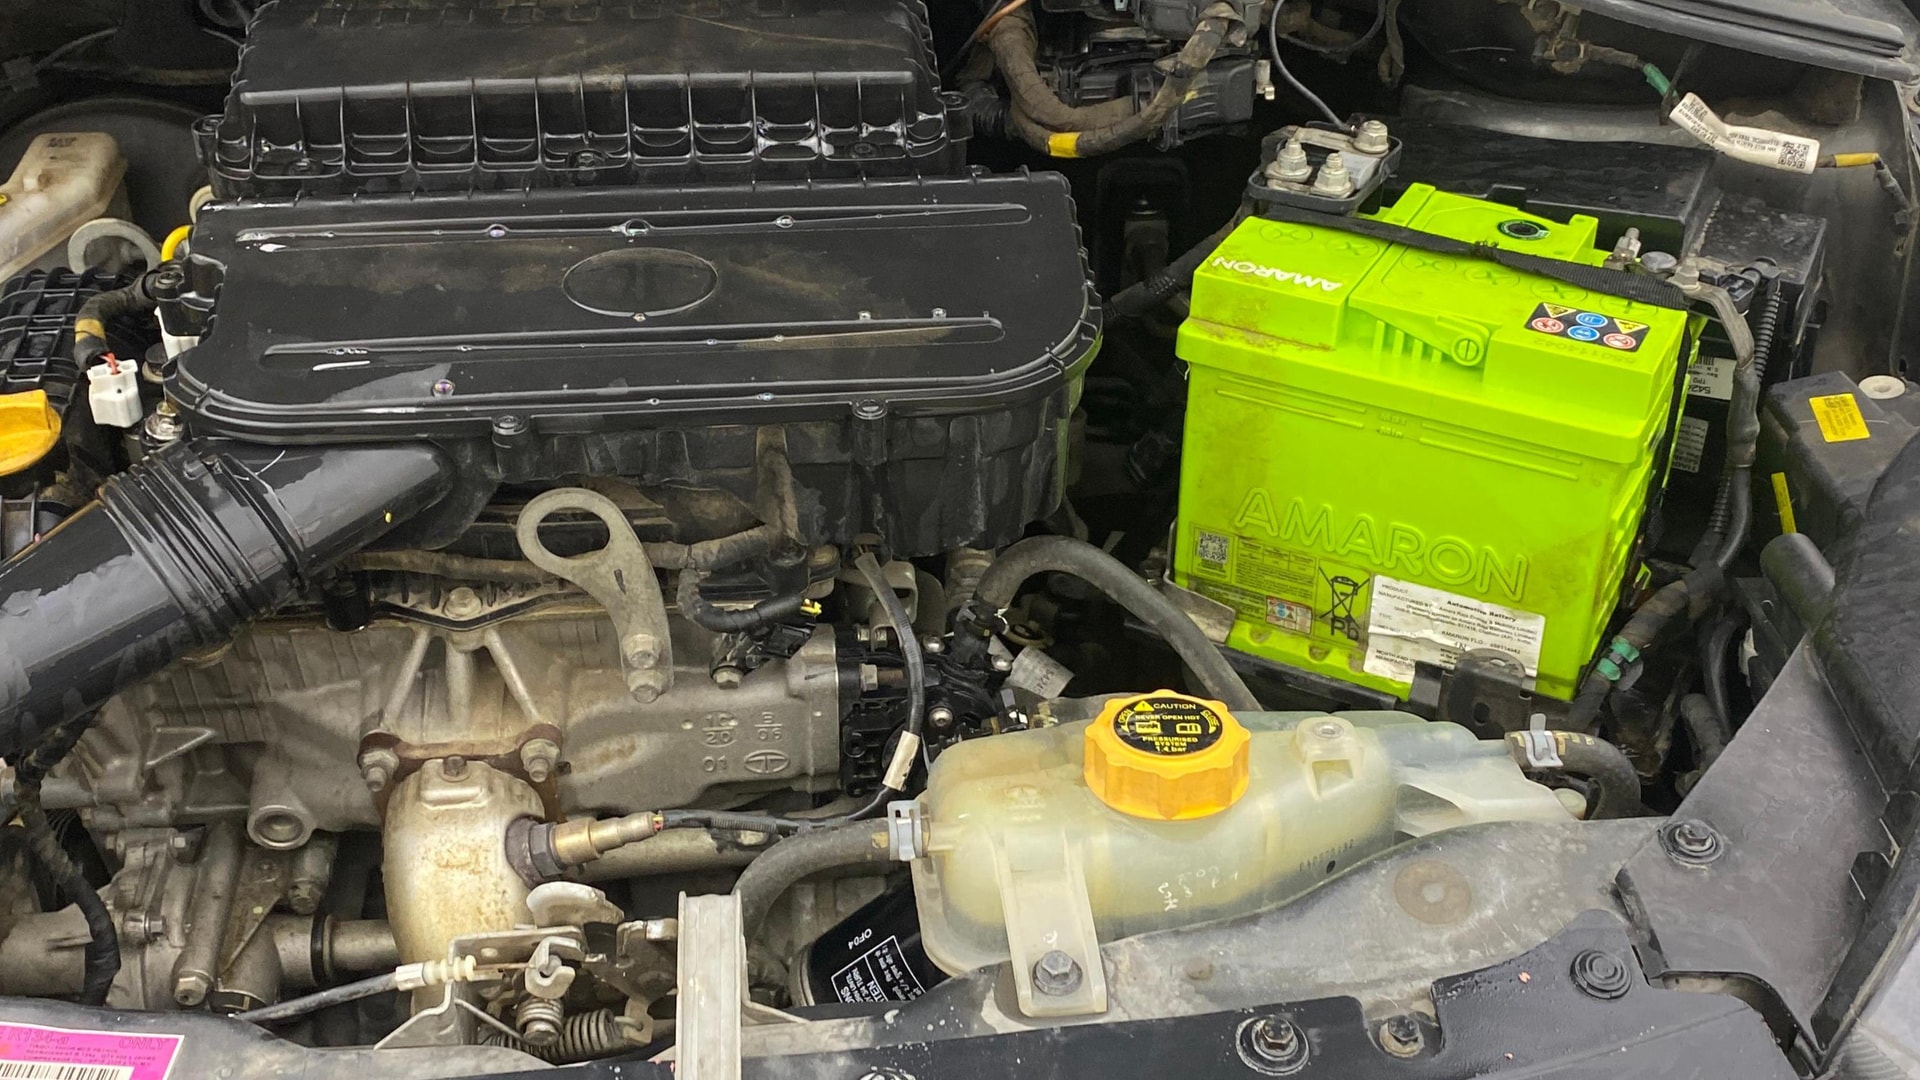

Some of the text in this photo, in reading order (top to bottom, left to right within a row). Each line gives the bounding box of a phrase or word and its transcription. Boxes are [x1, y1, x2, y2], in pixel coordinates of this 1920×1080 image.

[1212, 255, 1344, 293] AMARON
[1235, 487, 1529, 602] AMARON
[1330, 615, 1359, 642] Pb
[1441, 630, 1470, 642] AMARON
[118, 1037, 169, 1050] ONLY
